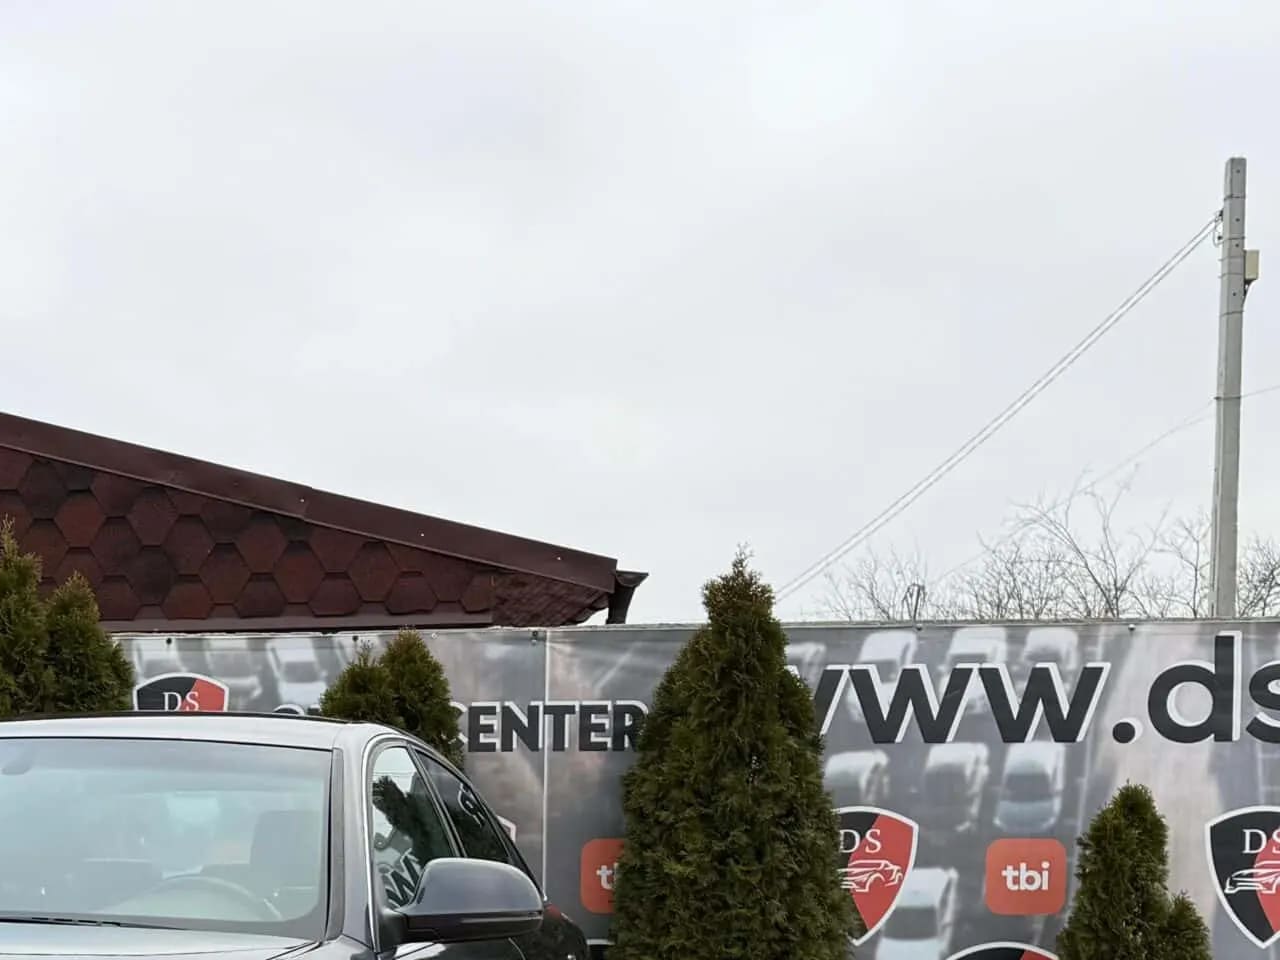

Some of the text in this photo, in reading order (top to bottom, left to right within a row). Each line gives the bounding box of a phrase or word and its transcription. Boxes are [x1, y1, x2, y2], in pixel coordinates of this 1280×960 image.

[808, 630, 1280, 744] ww.ds
[163, 691, 199, 712] DS
[839, 828, 882, 853] DS
[1001, 861, 1050, 892] tbi
